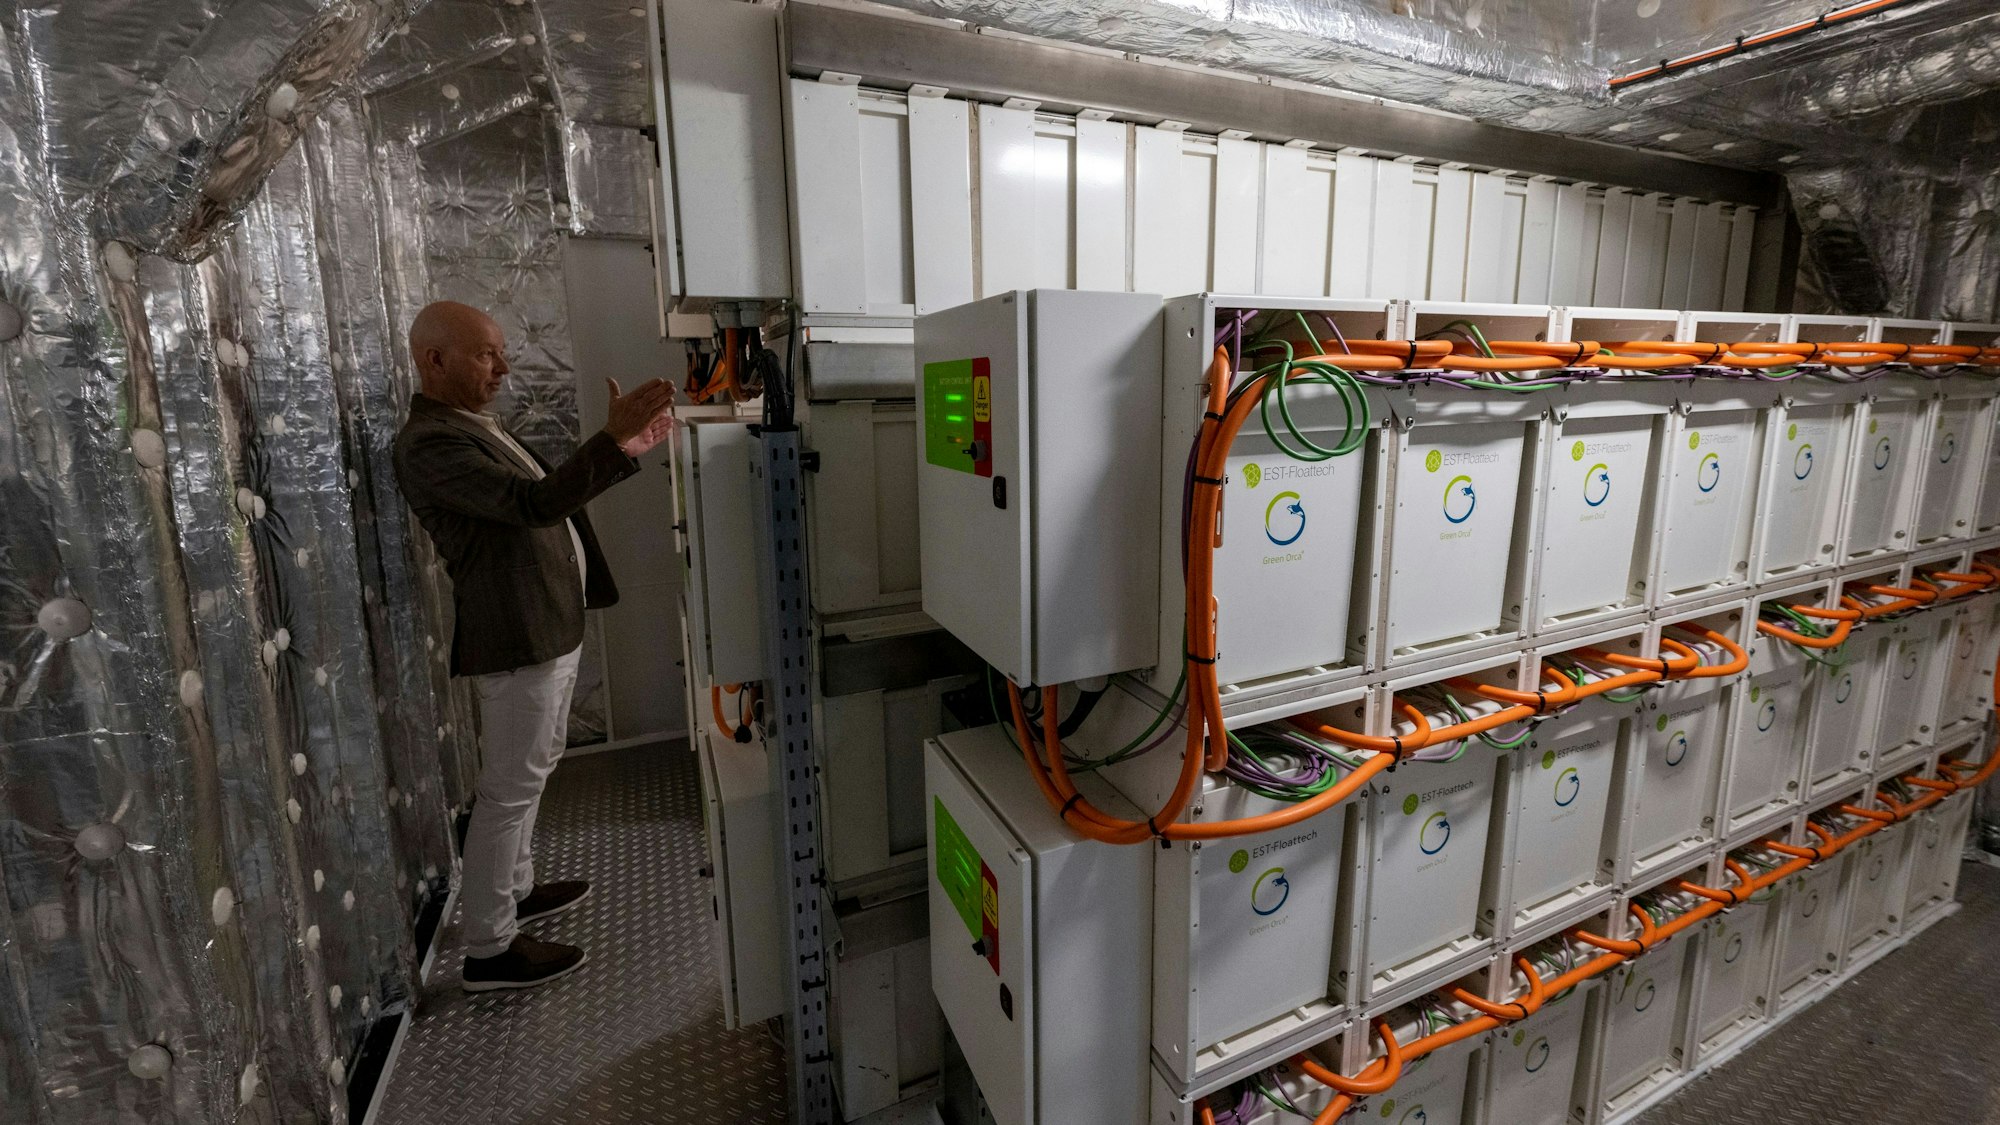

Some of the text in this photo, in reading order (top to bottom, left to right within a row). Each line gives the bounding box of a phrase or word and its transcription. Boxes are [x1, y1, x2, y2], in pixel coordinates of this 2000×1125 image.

[1585, 442, 1632, 456] EST-Floattech
[1443, 452, 1500, 467] EST-Floattech
[1263, 463, 1335, 482] EST-Floattech
[1439, 531, 1457, 541] Green
[1262, 551, 1303, 566] Green Orca
[1557, 739, 1601, 760] EST-Floattech
[1421, 780, 1474, 804] EST-Floattech
[1252, 829, 1318, 859] EST-Floattech
[1248, 922, 1271, 937] Green
